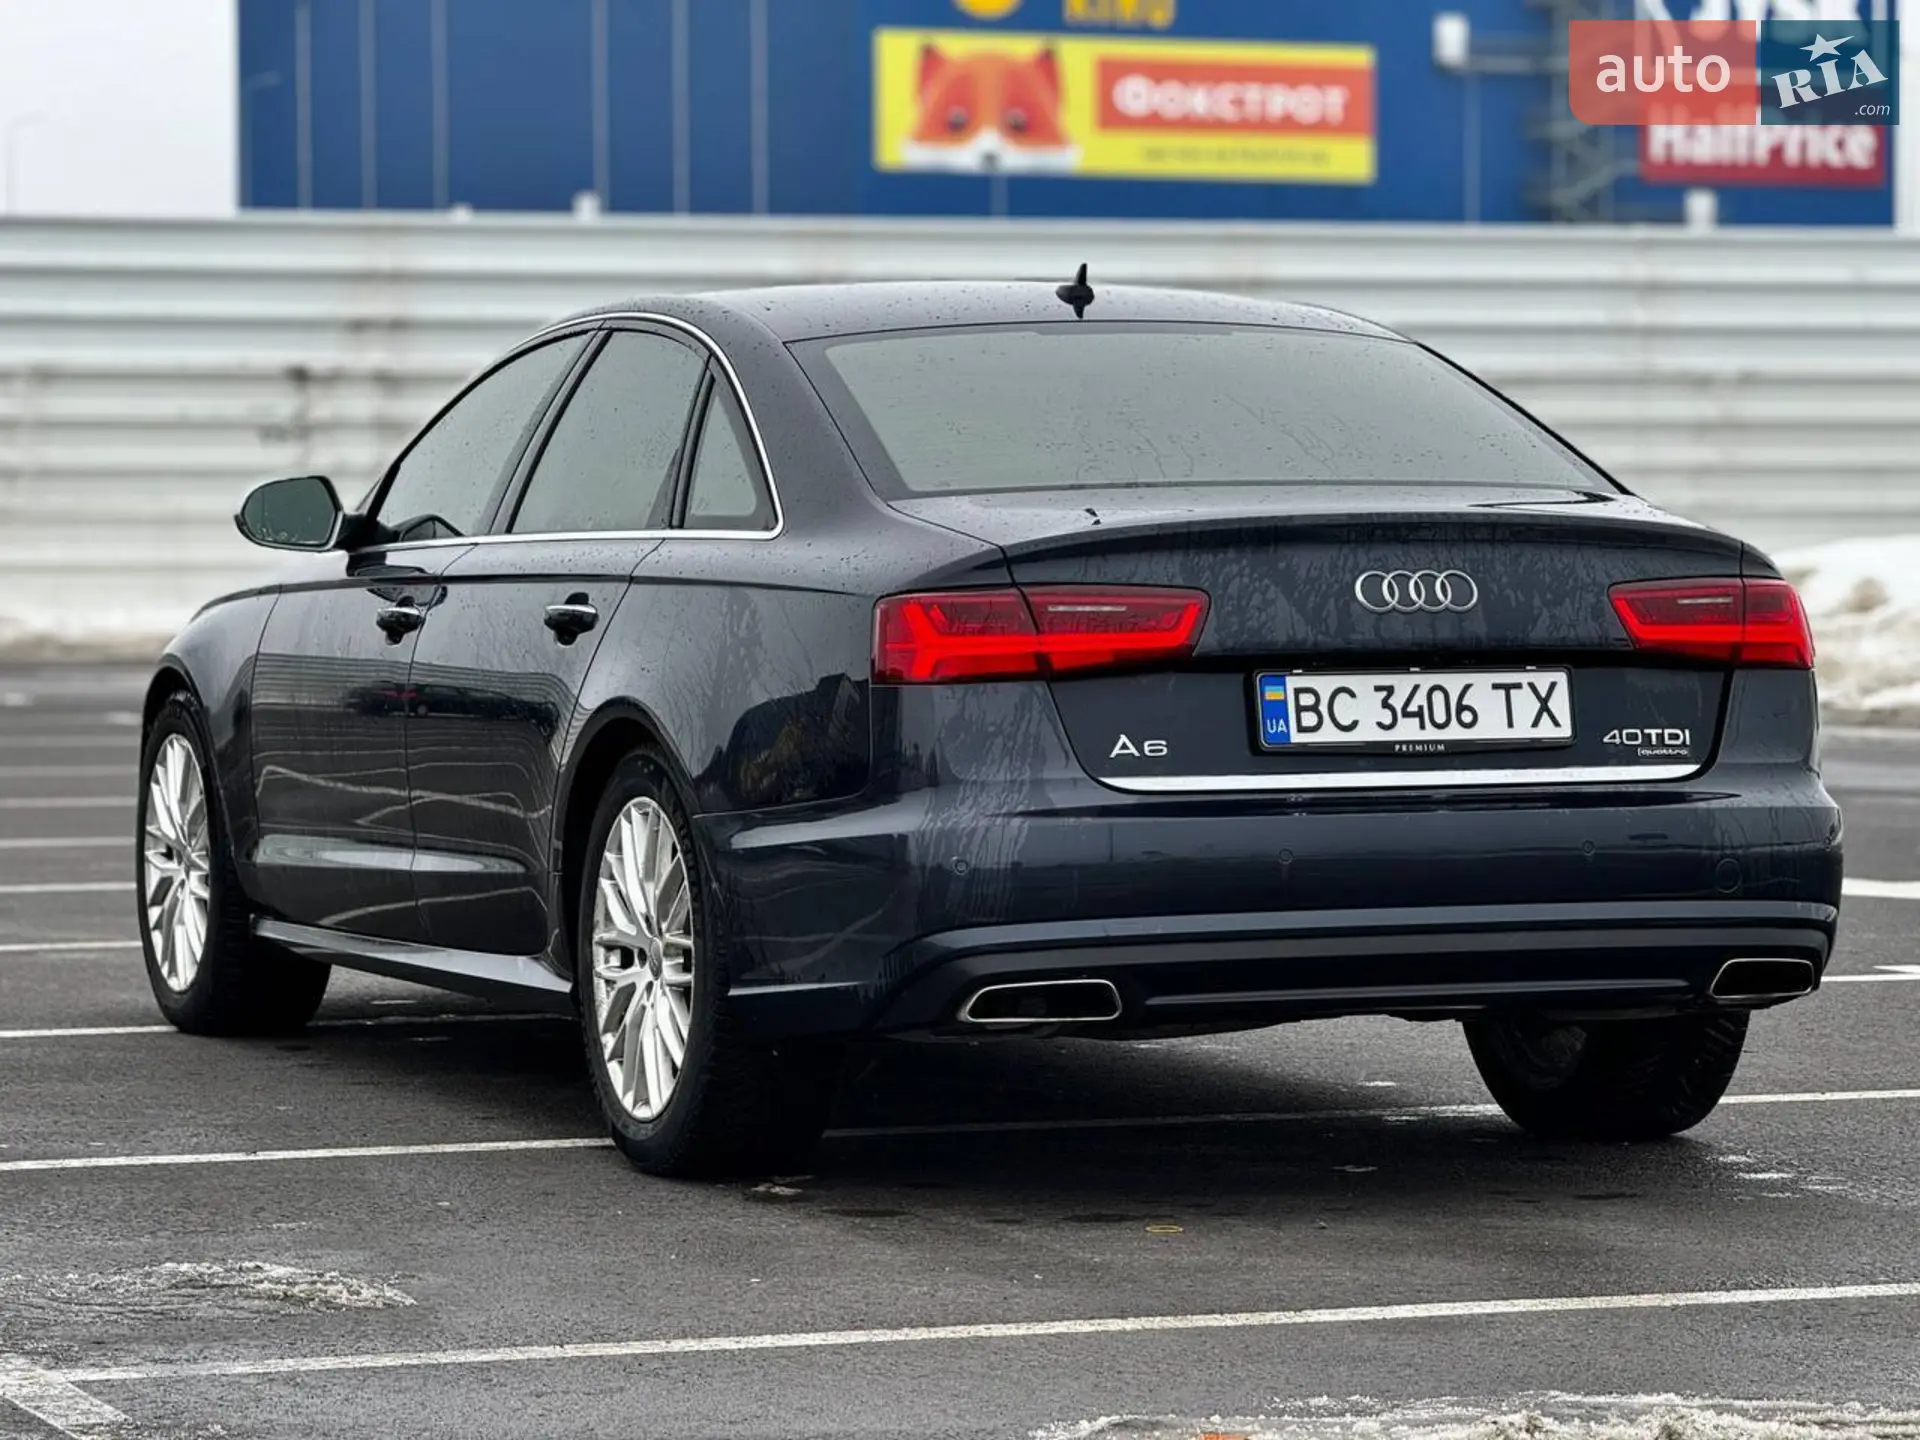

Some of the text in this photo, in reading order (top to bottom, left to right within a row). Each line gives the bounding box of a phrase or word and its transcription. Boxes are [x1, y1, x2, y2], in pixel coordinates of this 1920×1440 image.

[1293, 680, 1562, 734] BC 3406 TX
[1266, 718, 1288, 734] UA
[1108, 732, 1169, 759] A6
[1394, 743, 1446, 753] PREMIUM
